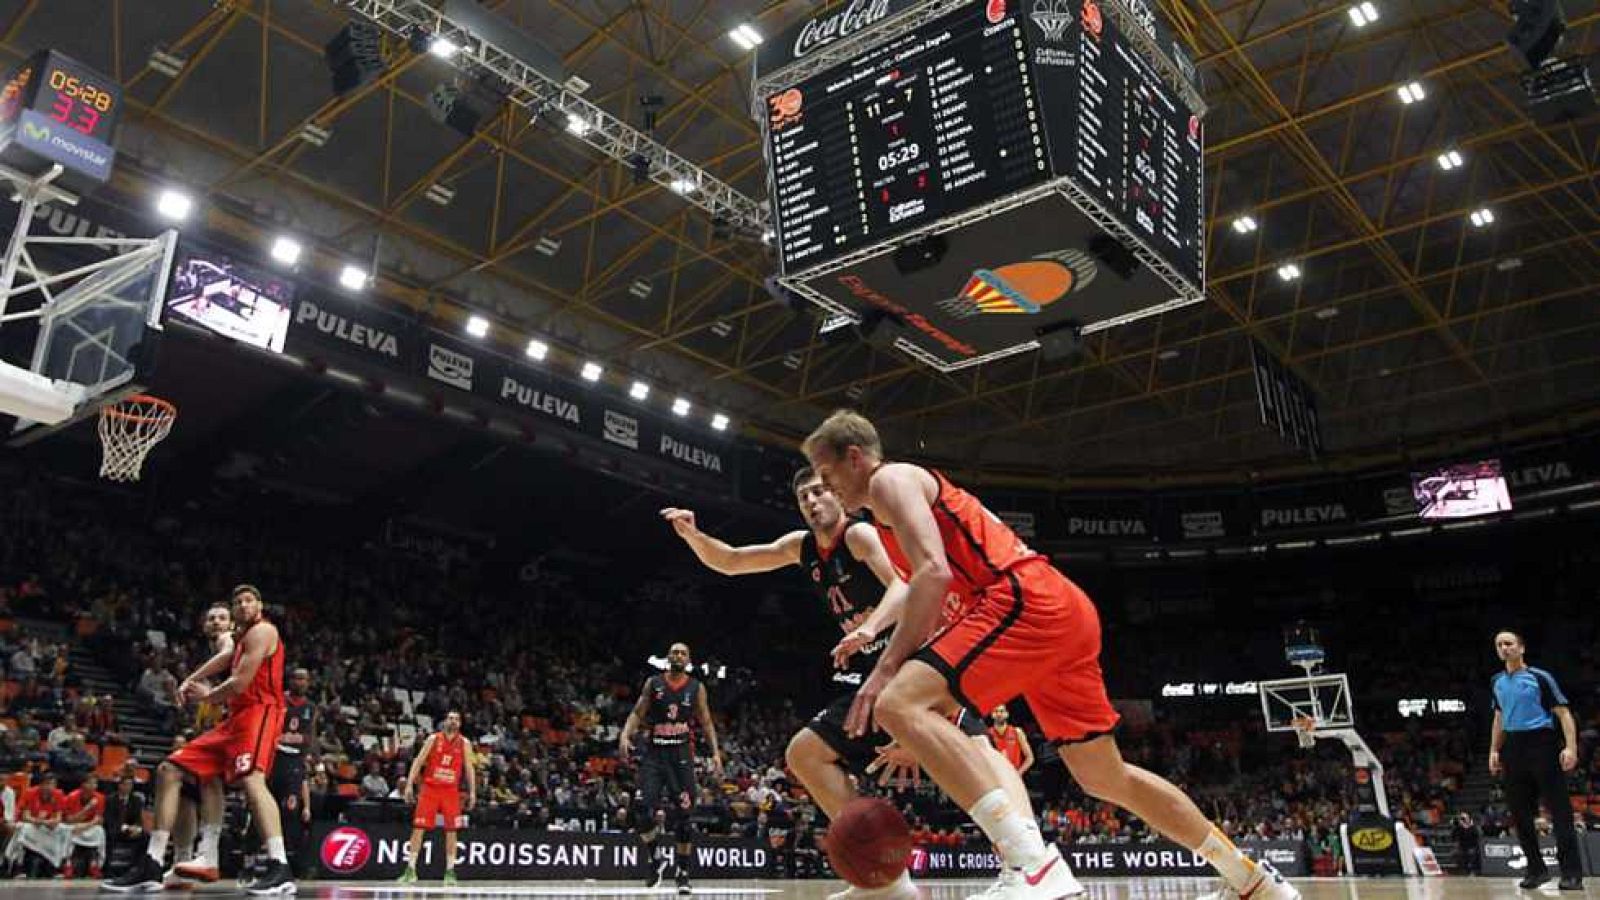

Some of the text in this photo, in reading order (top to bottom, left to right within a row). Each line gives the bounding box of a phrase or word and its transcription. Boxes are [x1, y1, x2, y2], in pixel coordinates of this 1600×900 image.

[48, 69, 113, 112] 05:28
[864, 103, 881, 118] 11
[904, 88, 914, 102] 7
[51, 93, 100, 135] 3.3
[51, 136, 107, 165] movistar
[878, 143, 919, 171] 05:29
[297, 301, 398, 357] PULEVA
[501, 376, 580, 424] PULEVA
[660, 434, 721, 473] PULEVA
[1068, 517, 1148, 536] PULEVA
[1261, 503, 1347, 526] PULEVA
[667, 703, 679, 720] 3
[1359, 831, 1387, 847] AP
[454, 842, 605, 867] CROISSANT
[613, 845, 638, 867] IN
[696, 847, 767, 868] WORLD
[1071, 851, 1116, 869] THE
[1122, 850, 1207, 868] WORLD
